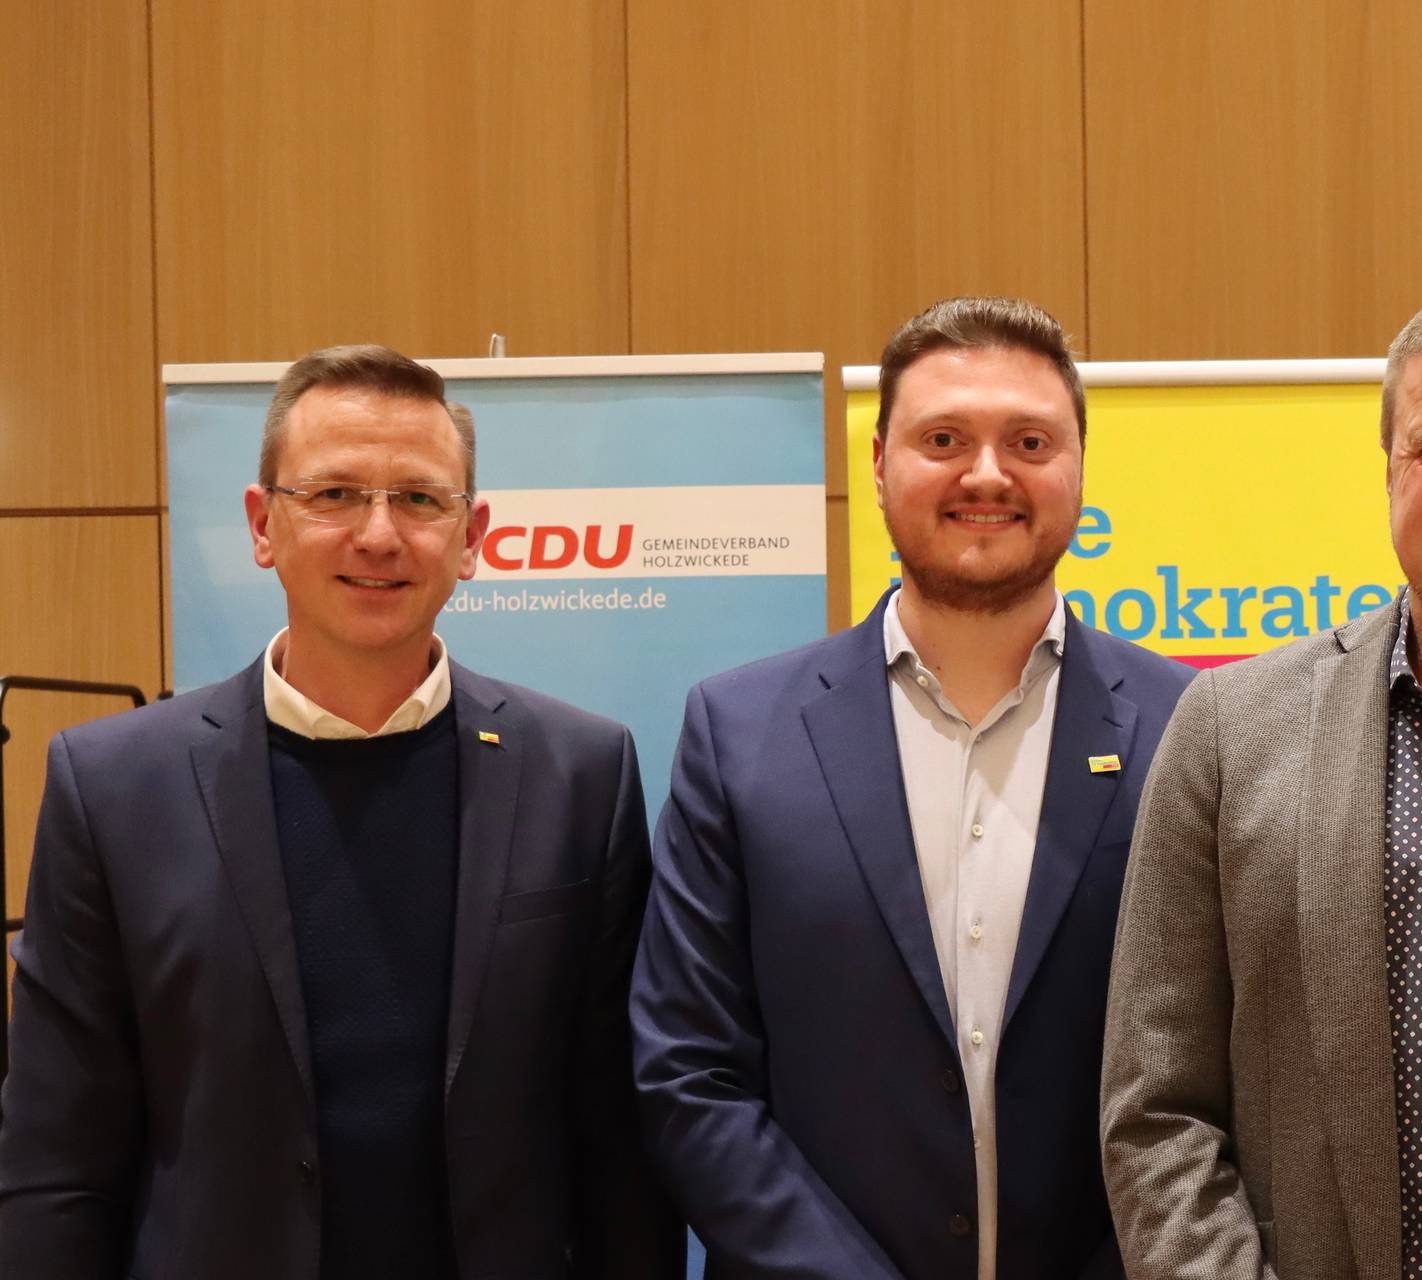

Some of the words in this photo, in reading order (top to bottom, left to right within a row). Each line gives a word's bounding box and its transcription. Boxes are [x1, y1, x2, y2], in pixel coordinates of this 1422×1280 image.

[481, 524, 635, 571] CDU
[642, 535, 791, 552] GEMEINDEVERBAND
[643, 553, 750, 569] HOLZWICKEDE
[443, 586, 667, 613] cdu-holzwickede.de
